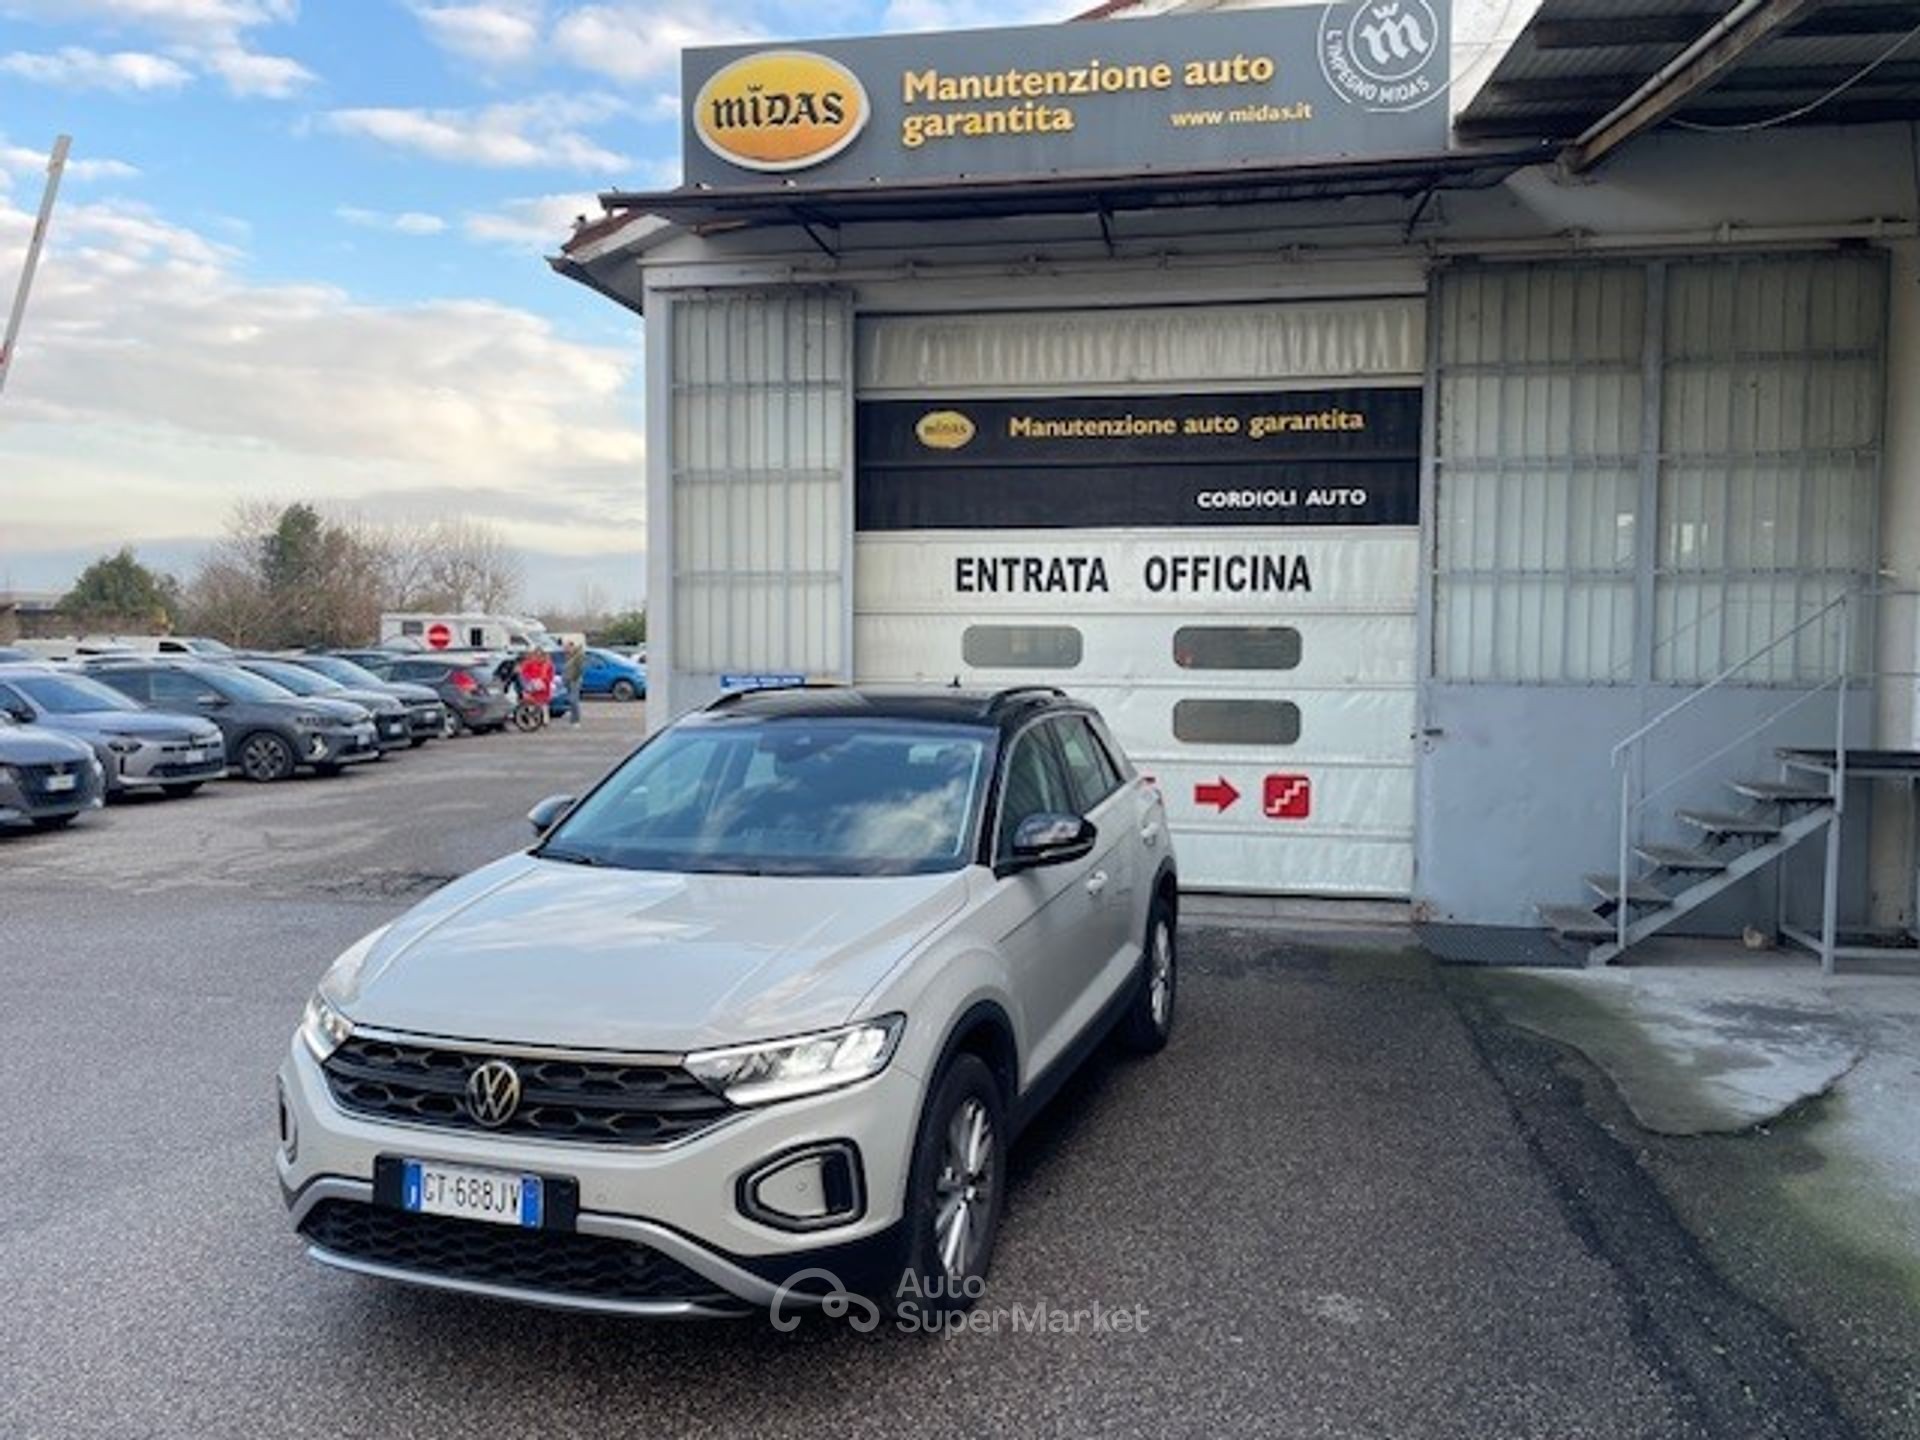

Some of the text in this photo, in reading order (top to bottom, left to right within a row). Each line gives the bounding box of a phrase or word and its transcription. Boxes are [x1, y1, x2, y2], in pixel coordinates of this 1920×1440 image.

[904, 53, 1275, 103] Manutenzione auto
[1380, 75, 1430, 102] MIDAS
[902, 102, 1074, 147] garantita
[1009, 408, 1364, 439] Manutenzione auto garantita
[1197, 488, 1367, 509] CORDIOLI AUTO
[955, 555, 1312, 593] ENTRATA OFFICINA
